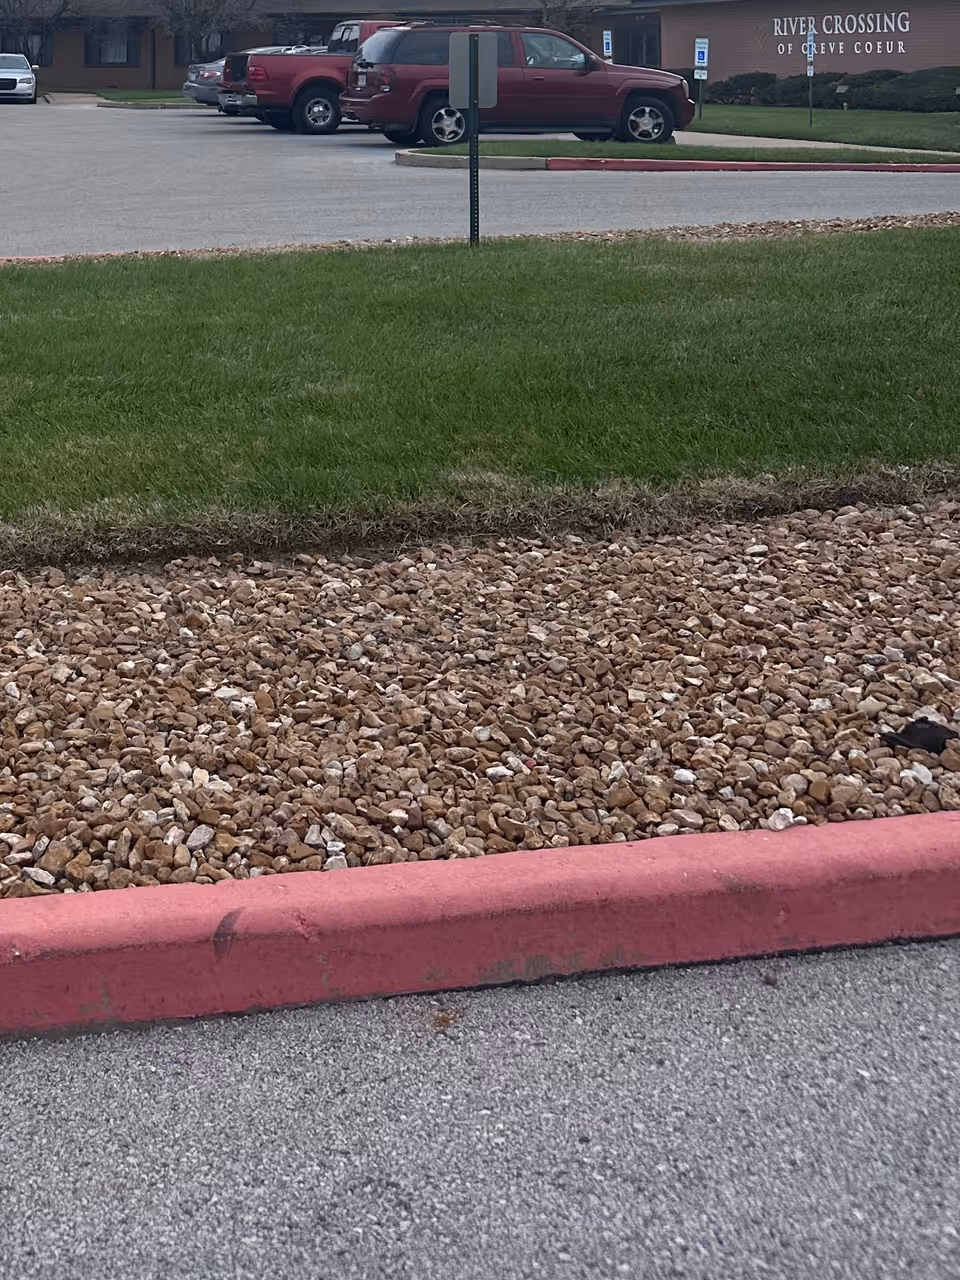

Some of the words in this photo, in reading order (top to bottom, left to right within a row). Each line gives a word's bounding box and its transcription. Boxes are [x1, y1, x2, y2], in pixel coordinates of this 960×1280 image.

[773, 17, 818, 36] RIVER
[822, 12, 910, 34] CROSSING
[778, 43, 792, 54] OF
[854, 41, 905, 53] COEUR
